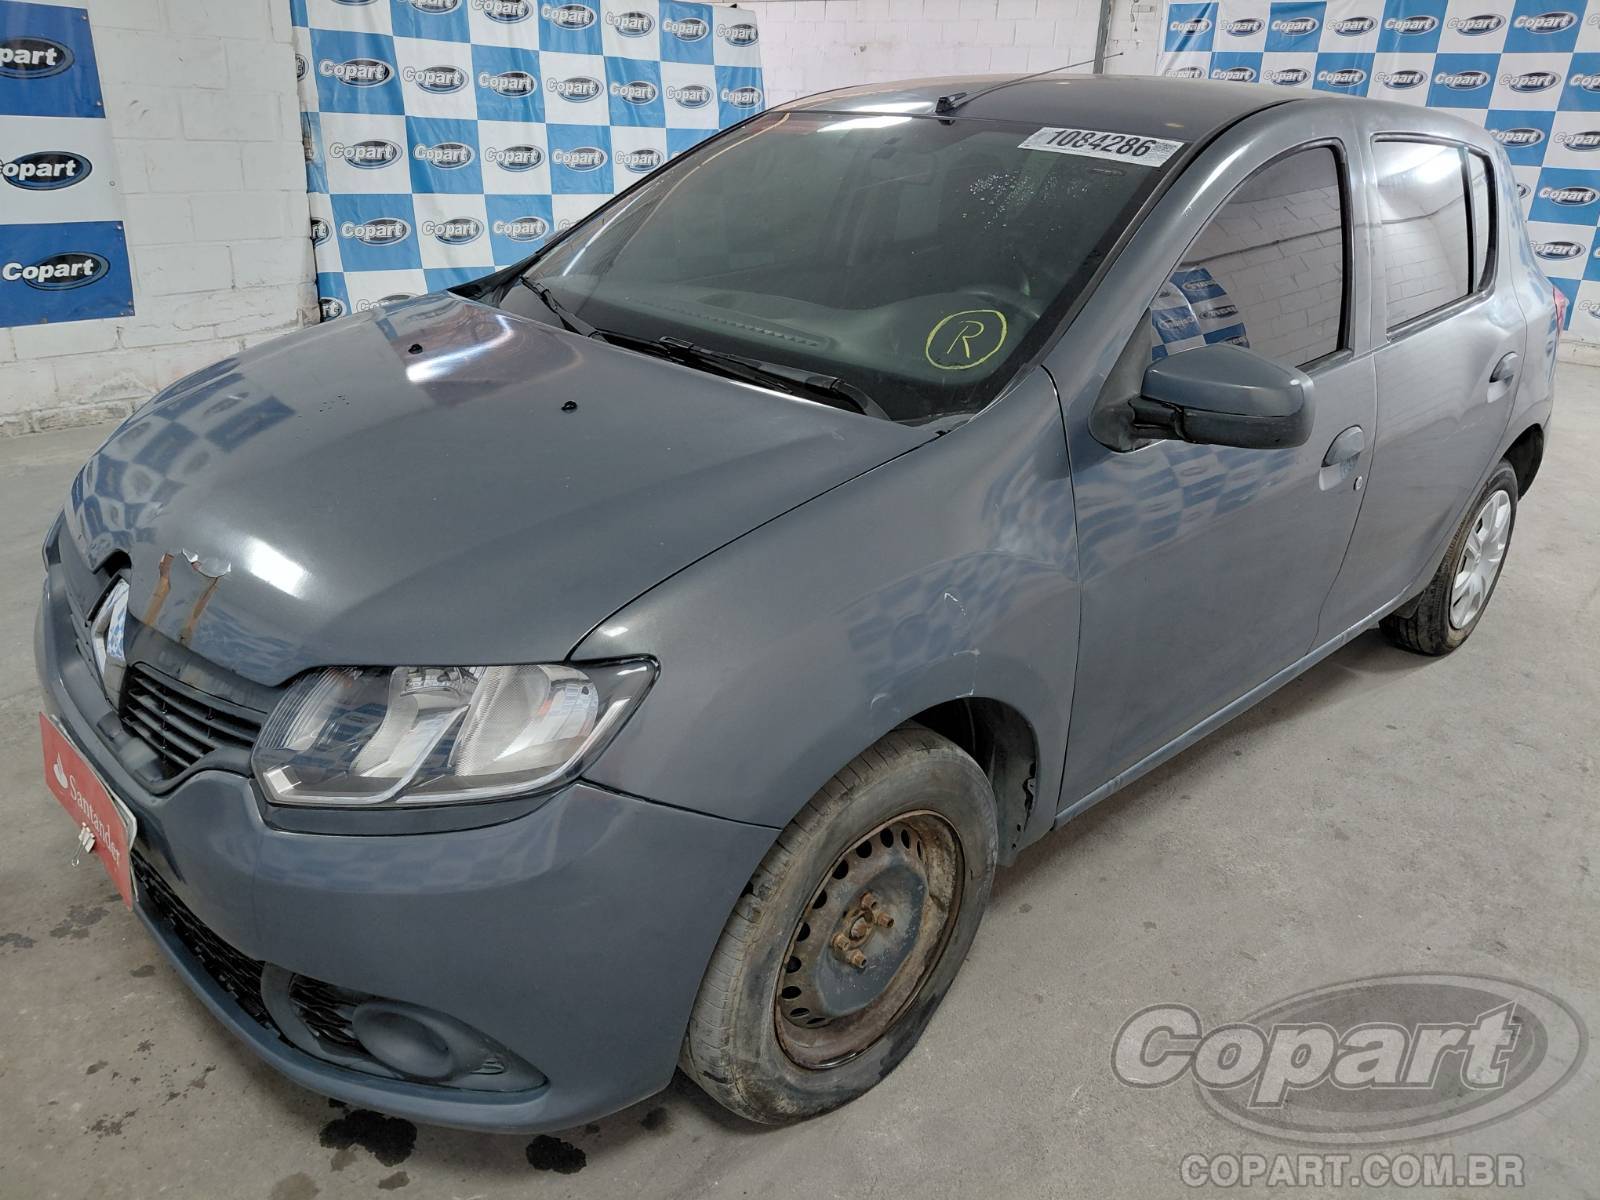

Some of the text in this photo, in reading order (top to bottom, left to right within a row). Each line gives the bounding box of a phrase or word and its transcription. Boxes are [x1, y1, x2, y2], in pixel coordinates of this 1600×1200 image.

[541, 5, 591, 24] Copart
[606, 12, 649, 31] Copart
[1447, 16, 1497, 31] Copart
[1514, 14, 1570, 30] Copart
[663, 18, 704, 37] Copart
[717, 24, 757, 42] Copart
[1169, 20, 1208, 33] Copart
[1219, 20, 1260, 33] Copart
[1271, 18, 1313, 32] Copart
[1327, 18, 1371, 33] Copart
[1384, 17, 1432, 32] Copart
[0, 48, 57, 66] part
[320, 59, 385, 80] Copart
[403, 66, 462, 86] Copart
[1212, 68, 1252, 80] Copart
[1263, 69, 1307, 82] Copart
[1317, 70, 1361, 84] Copart
[1375, 72, 1420, 85] Copart
[479, 72, 532, 91] Copart
[546, 77, 596, 96] Copart
[1435, 72, 1485, 87] Copart
[1499, 73, 1551, 88] Copart
[610, 81, 653, 100] Copart
[666, 86, 706, 102] Copart
[720, 87, 759, 105] Copart
[1046, 130, 1157, 157] 1084286
[1554, 132, 1600, 147] Copar
[330, 142, 394, 161] Copart
[414, 144, 467, 162] Copart
[485, 147, 540, 166] Copart
[552, 149, 602, 167] Copart
[615, 151, 658, 166] Copart
[0, 159, 76, 181] opart
[1539, 187, 1593, 203] Copart
[341, 221, 403, 240] Copart
[422, 220, 477, 239] Copart
[493, 220, 541, 238] Copart
[2, 259, 94, 282] Copart
[947, 320, 984, 359] R
[69, 774, 121, 867] Santander
